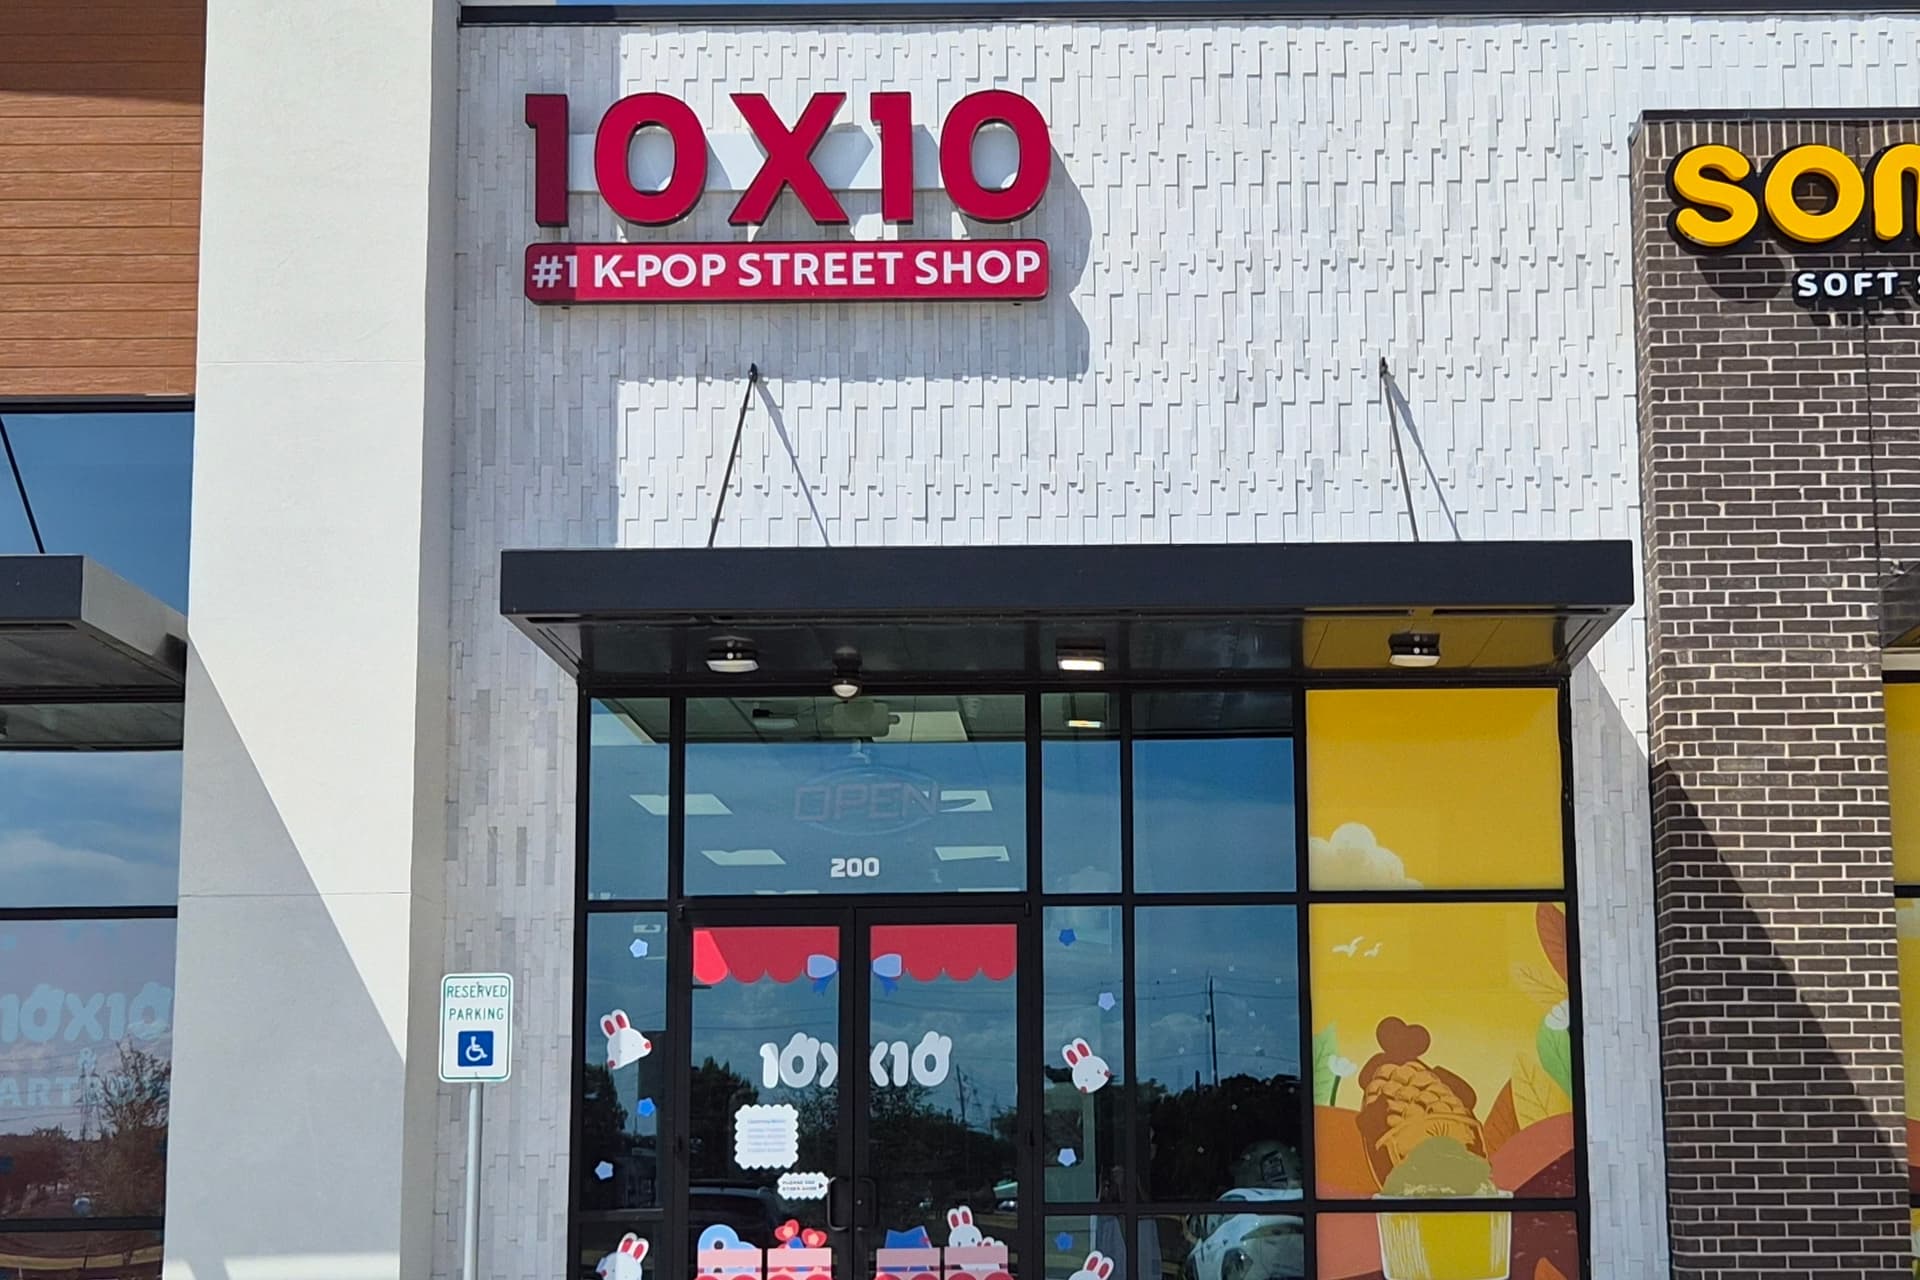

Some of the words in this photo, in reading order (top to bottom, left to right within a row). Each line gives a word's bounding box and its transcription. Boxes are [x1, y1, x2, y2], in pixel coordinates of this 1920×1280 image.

[525, 90, 1051, 226] 10X10
[531, 254, 577, 288] #1
[593, 253, 727, 288] K-POP
[737, 251, 904, 287] STREET
[914, 249, 1042, 285] SHOP
[1796, 271, 1900, 297] SOFT
[792, 782, 939, 822] OPEN
[830, 856, 880, 878] 200
[446, 984, 508, 998] RESERVED
[449, 1007, 505, 1020] PARKING
